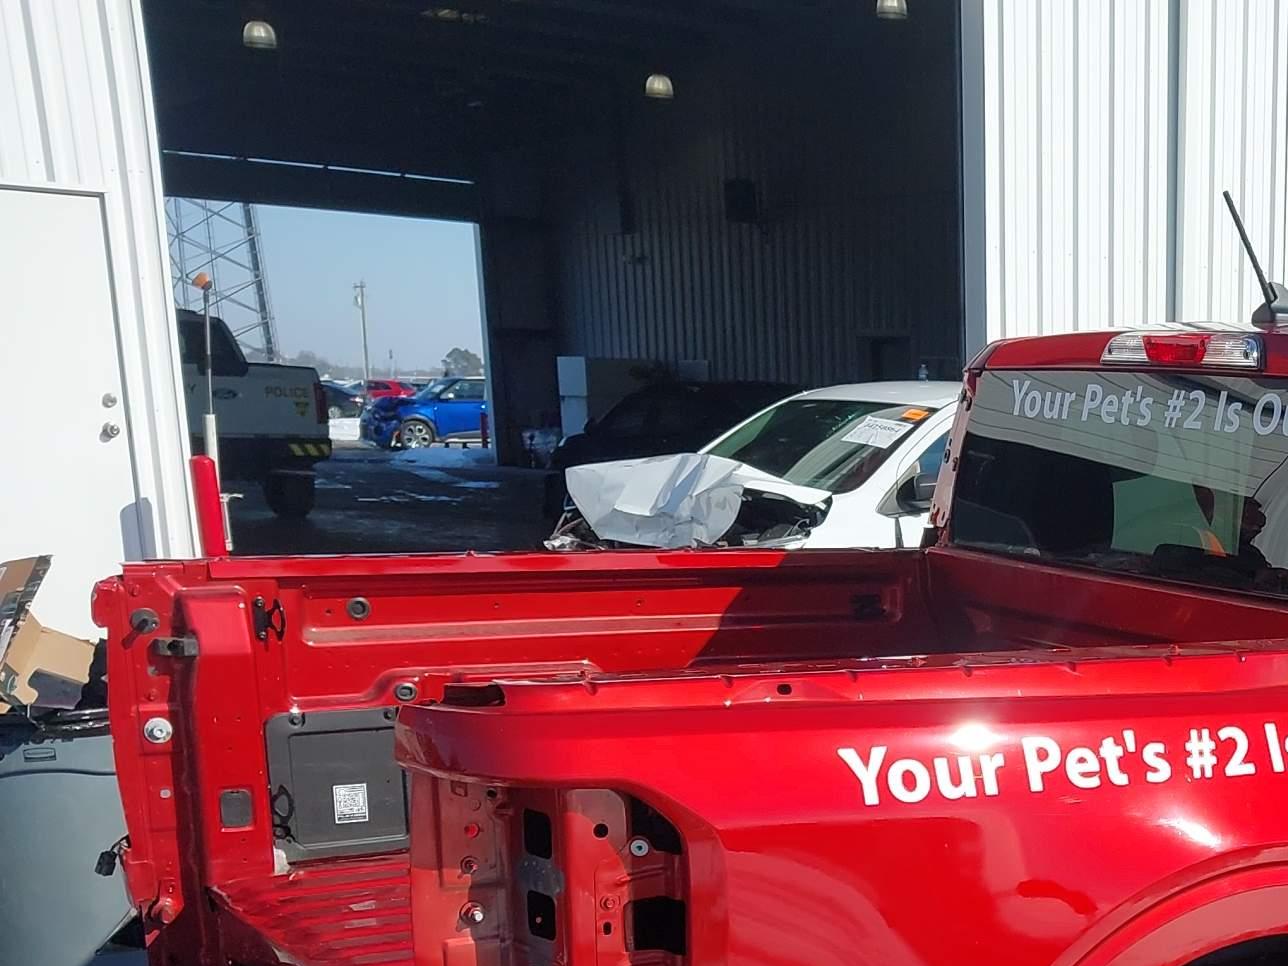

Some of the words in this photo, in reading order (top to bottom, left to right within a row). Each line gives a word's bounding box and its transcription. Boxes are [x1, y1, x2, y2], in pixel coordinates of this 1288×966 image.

[264, 385, 310, 399] POLICE
[1012, 379, 1076, 420] Your
[1081, 383, 1154, 427] Pet's
[1164, 389, 1206, 430] #2
[1213, 390, 1243, 433] Is
[837, 745, 1004, 806] Your
[1022, 729, 1172, 793] Pet's
[1185, 726, 1256, 779] #2
